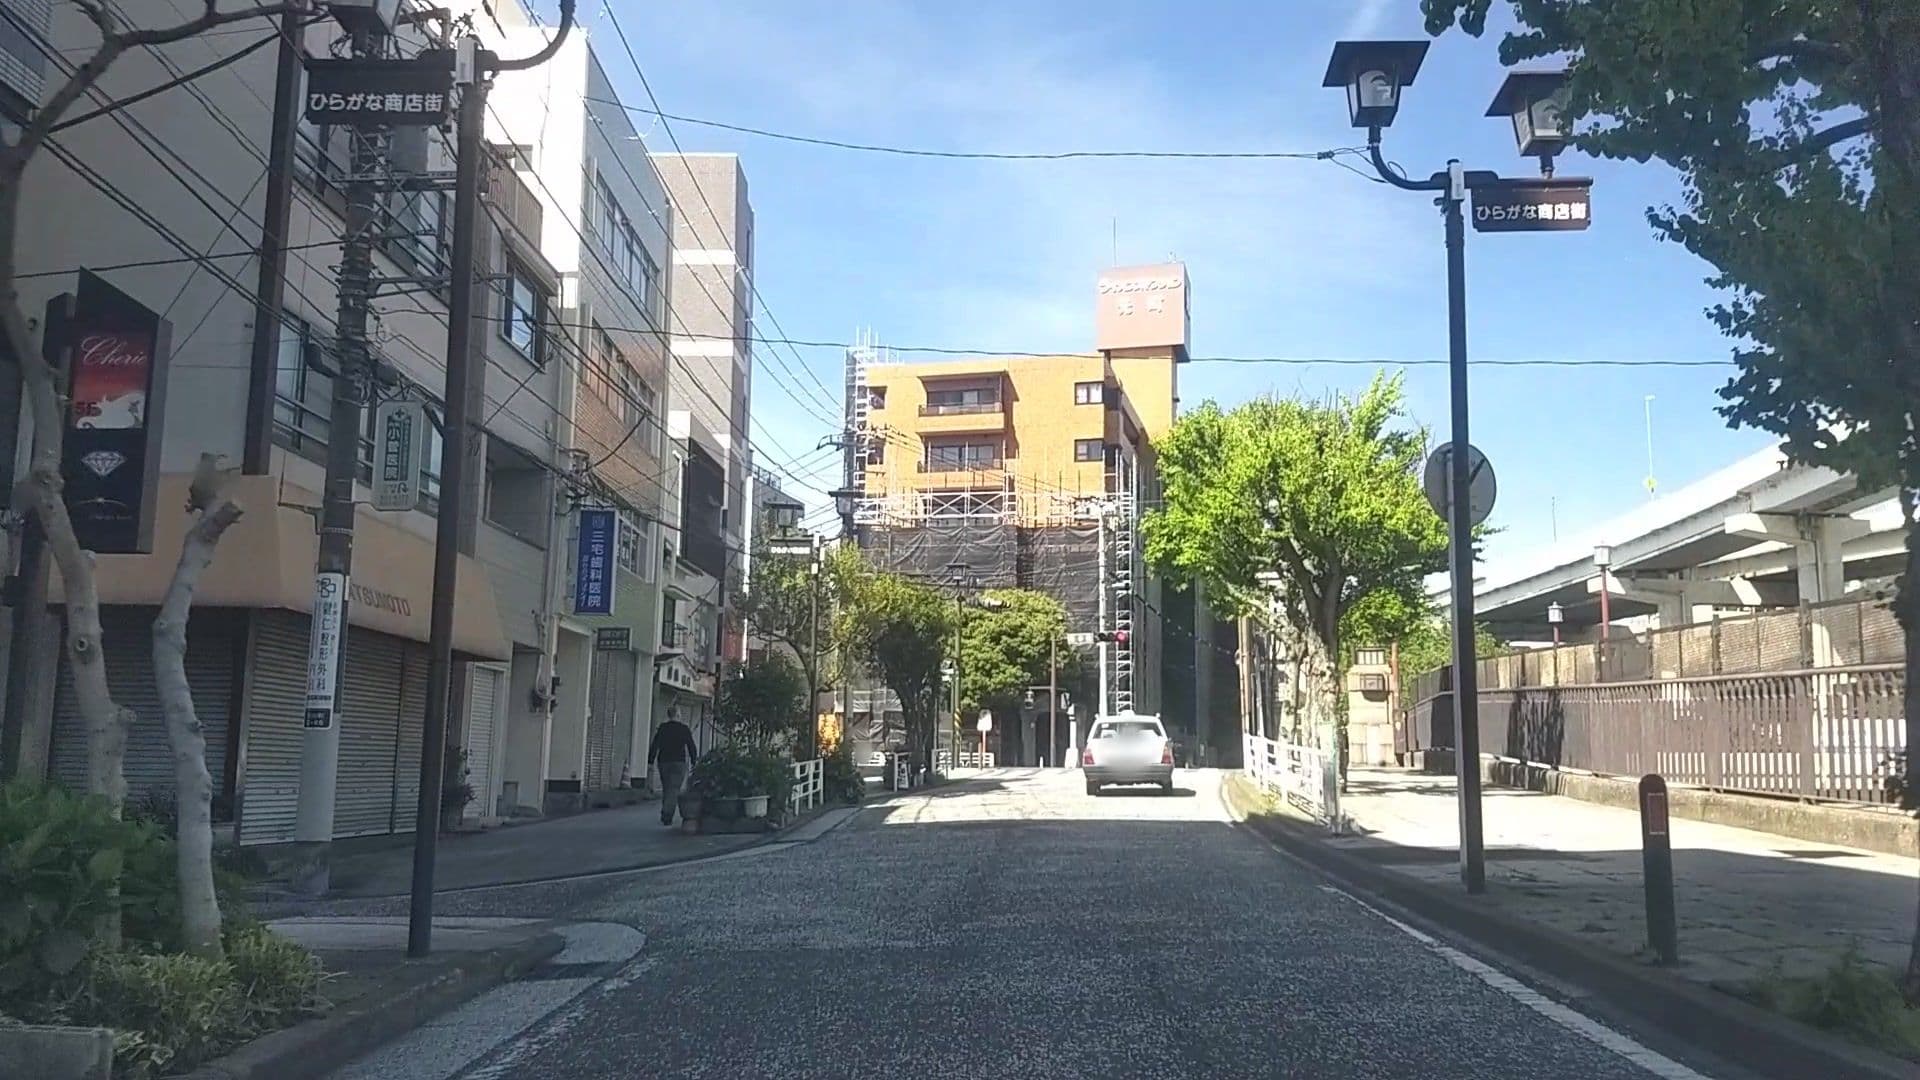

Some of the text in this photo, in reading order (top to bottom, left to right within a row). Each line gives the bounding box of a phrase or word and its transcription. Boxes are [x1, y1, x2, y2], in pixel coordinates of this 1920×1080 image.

[309, 92, 443, 113] ひらがな商店街
[1475, 202, 1587, 221] ひらがな商店街
